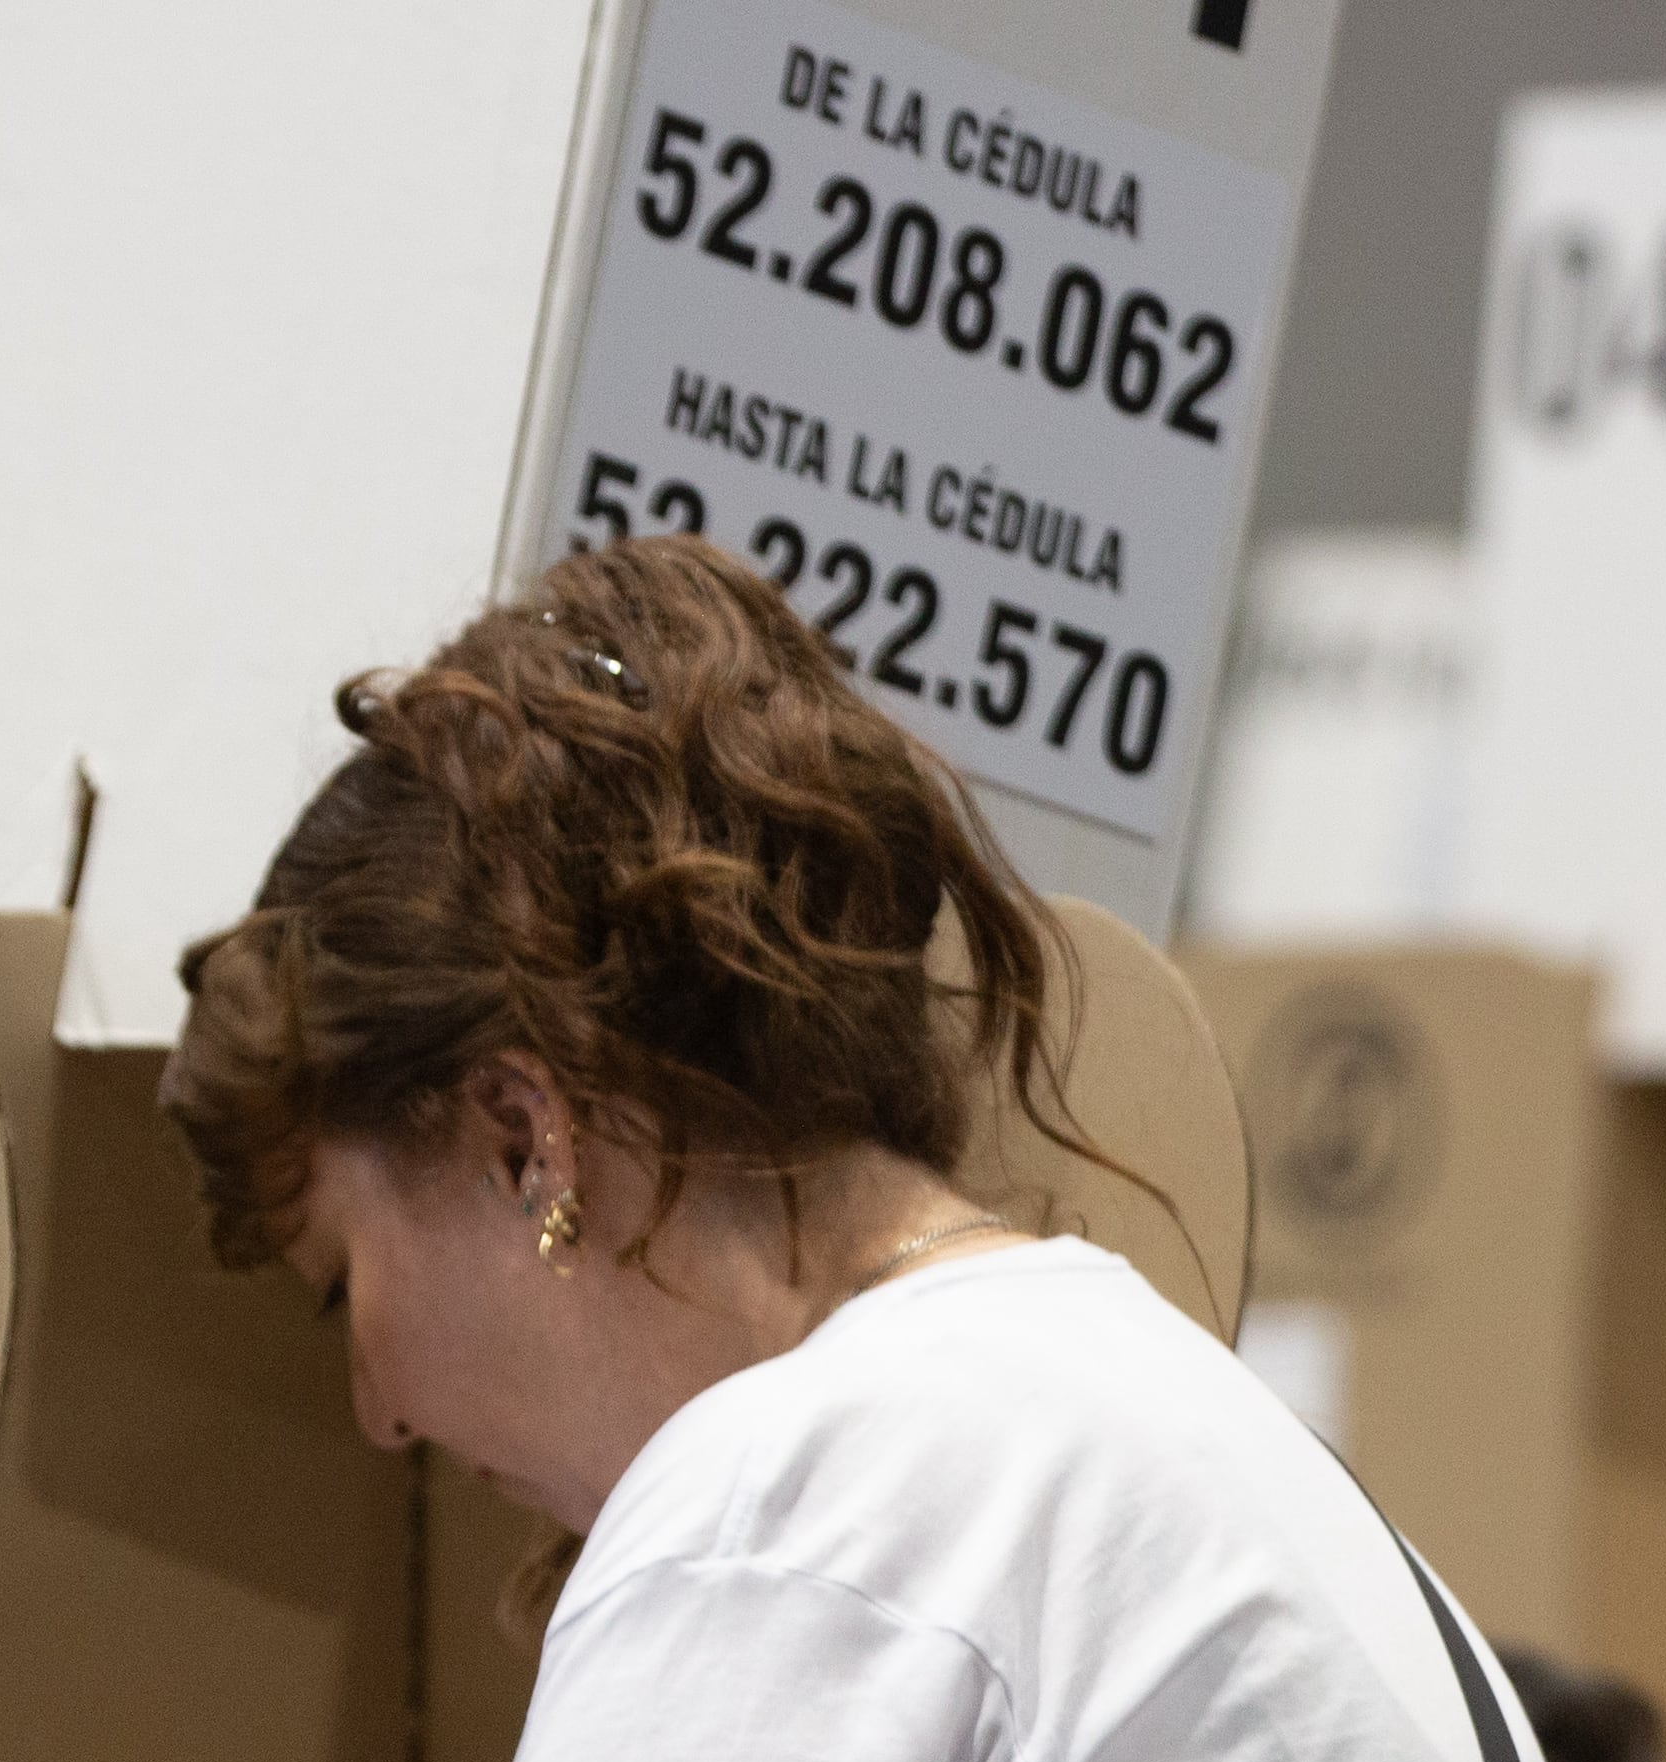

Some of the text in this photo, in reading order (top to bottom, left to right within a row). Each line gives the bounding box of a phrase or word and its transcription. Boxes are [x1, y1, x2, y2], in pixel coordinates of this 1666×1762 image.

[779, 43, 1141, 241] DE LA CÉDULA
[635, 104, 1239, 449] 52.208.062
[665, 366, 1125, 594] HASTA LA CÉDULA
